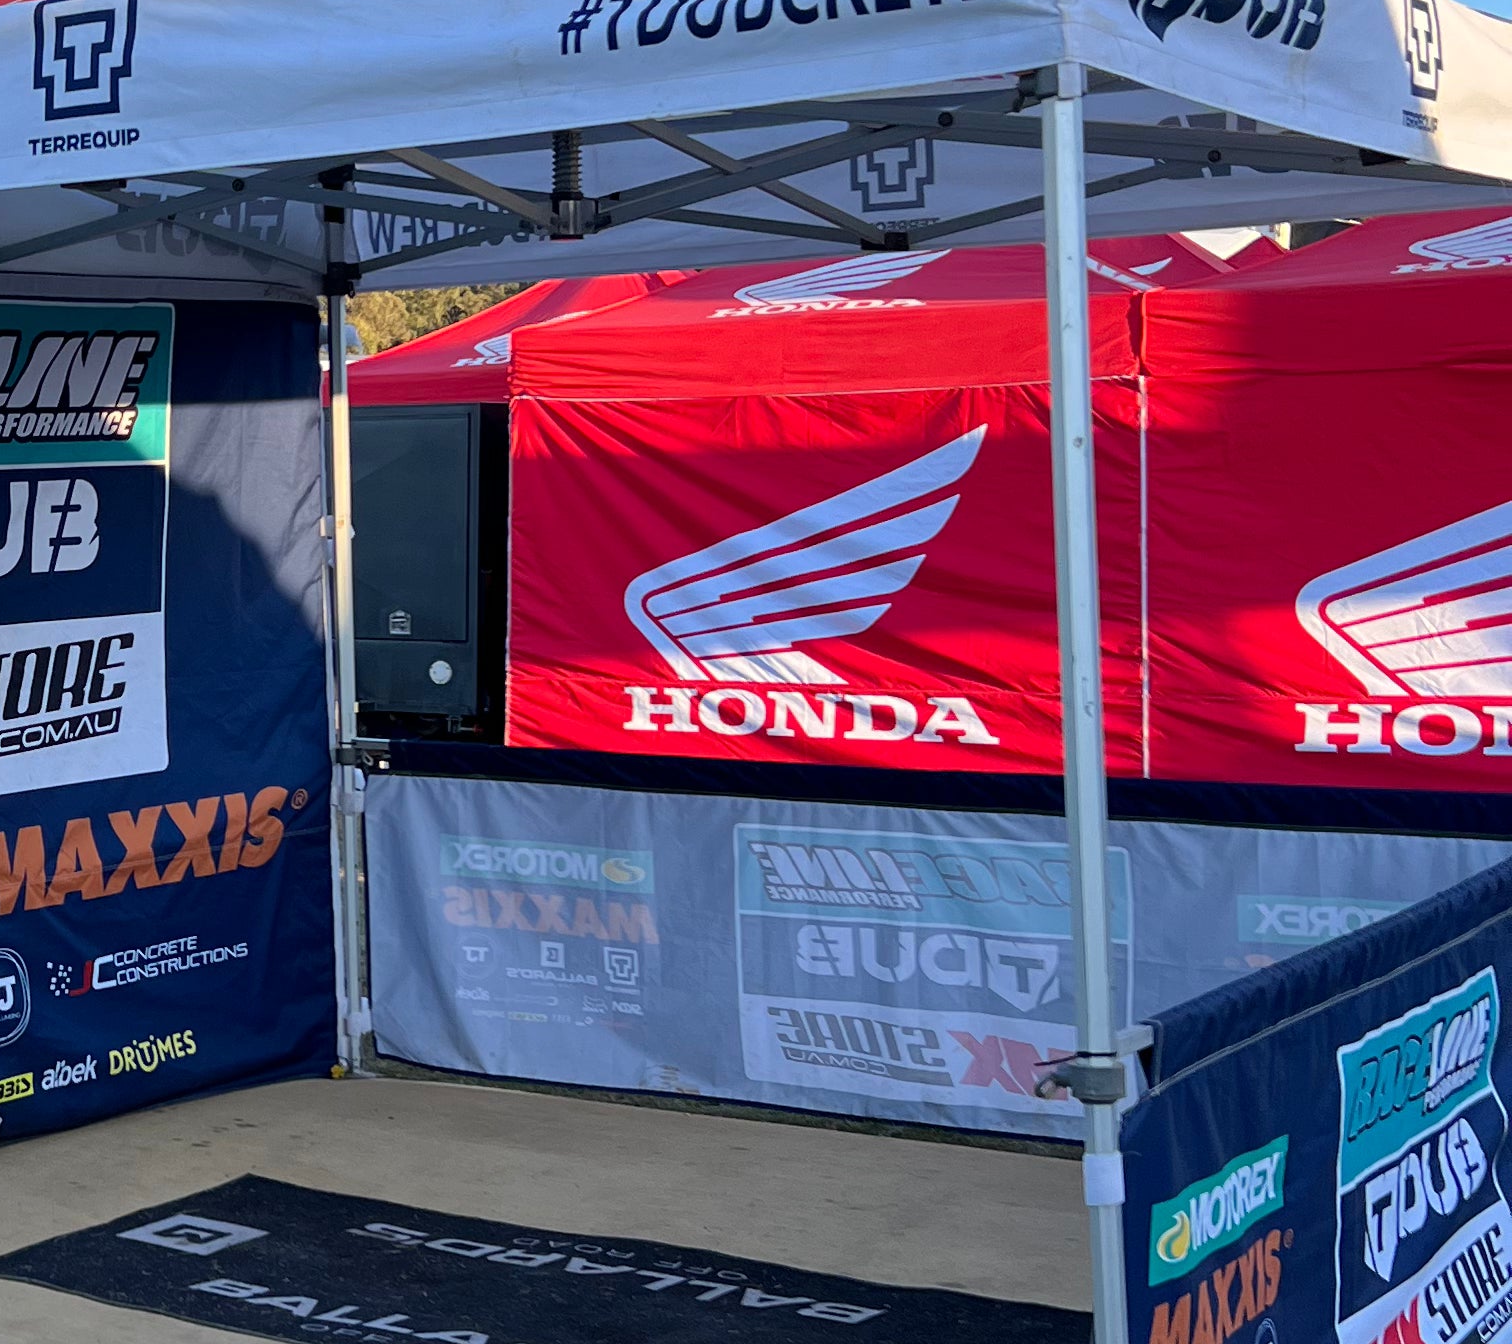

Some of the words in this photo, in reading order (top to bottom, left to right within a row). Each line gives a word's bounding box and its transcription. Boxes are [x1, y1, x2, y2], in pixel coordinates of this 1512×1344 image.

[29, 129, 140, 155] TERREQUIP
[707, 297, 927, 320] HONDA
[623, 685, 999, 747] HONDA
[113, 935, 198, 967] CONCRETE
[116, 942, 248, 987] CONSTRUCTIONS
[1189, 1152, 1281, 1253] MOTOREX
[300, 1322, 394, 1344] OFF
